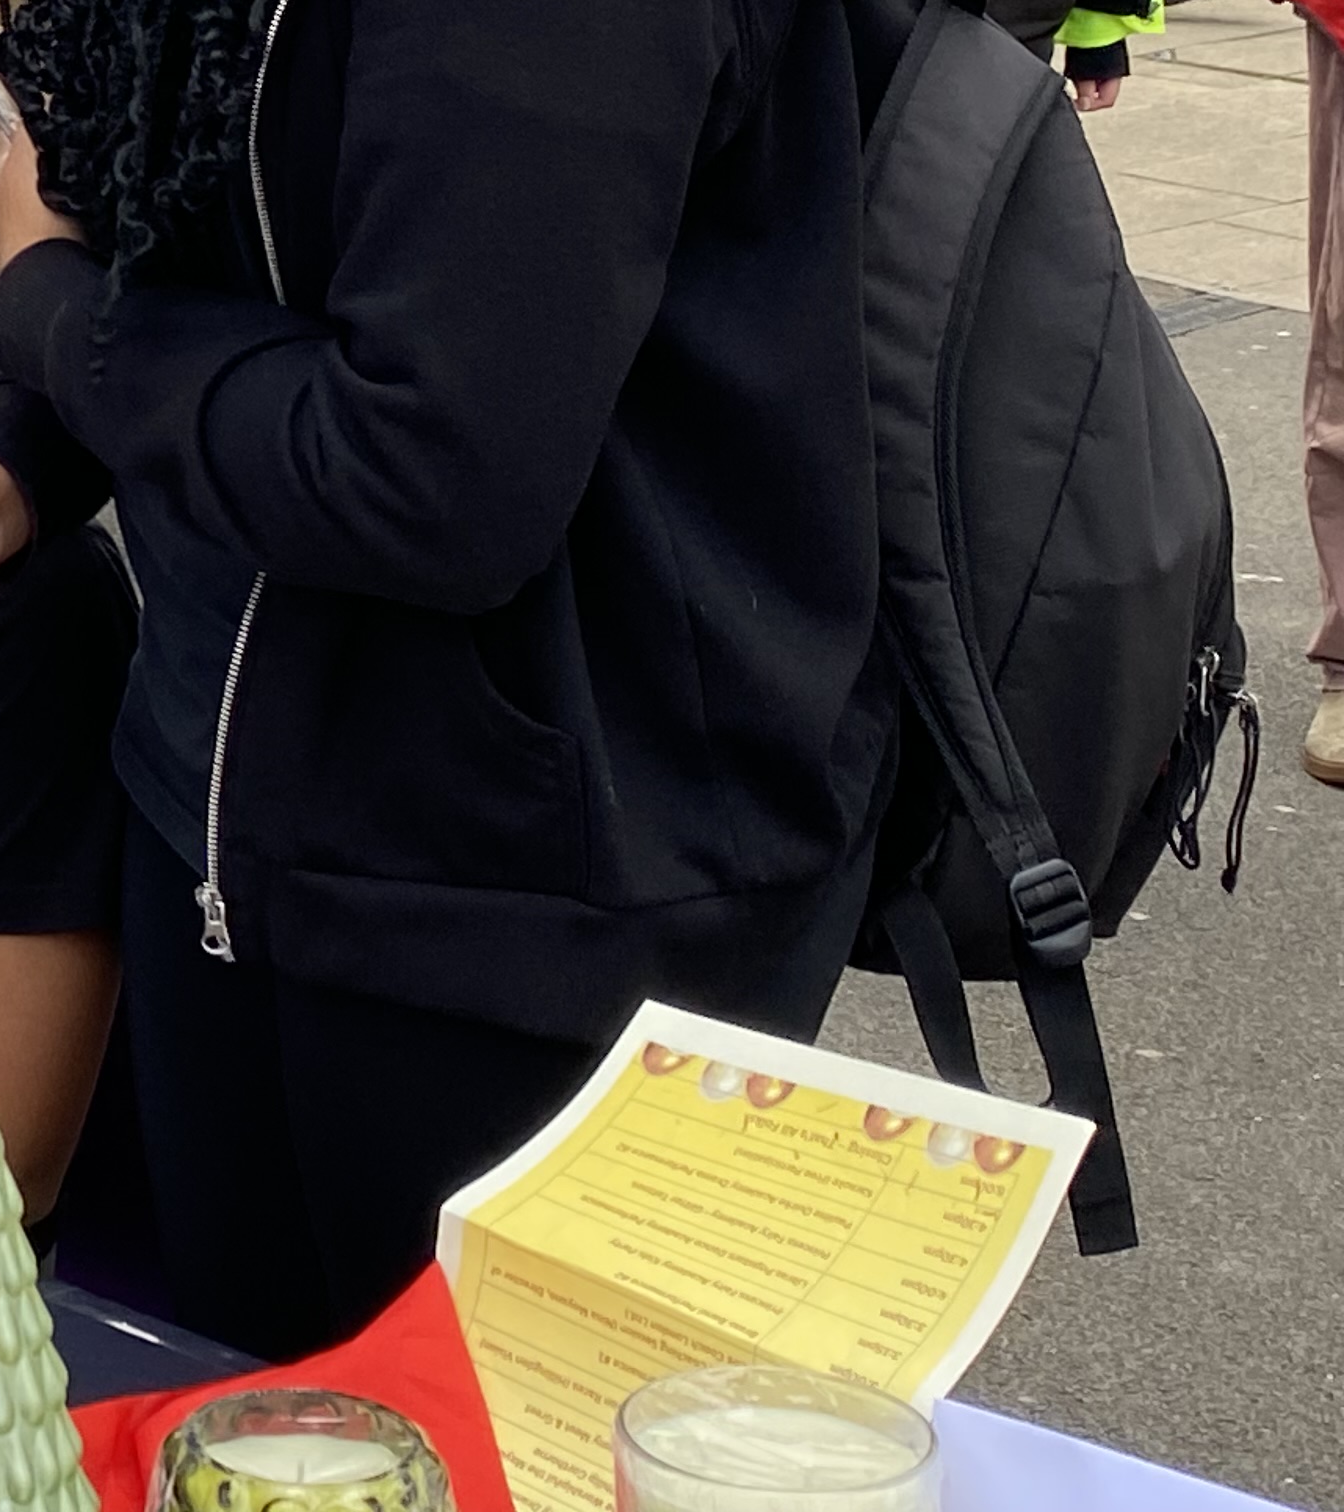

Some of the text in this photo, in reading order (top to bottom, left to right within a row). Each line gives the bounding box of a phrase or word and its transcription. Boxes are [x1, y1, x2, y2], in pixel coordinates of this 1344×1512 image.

[848, 1141, 892, 1165] Closing
[490, 1266, 502, 1277] of
[650, 1319, 689, 1346] London
